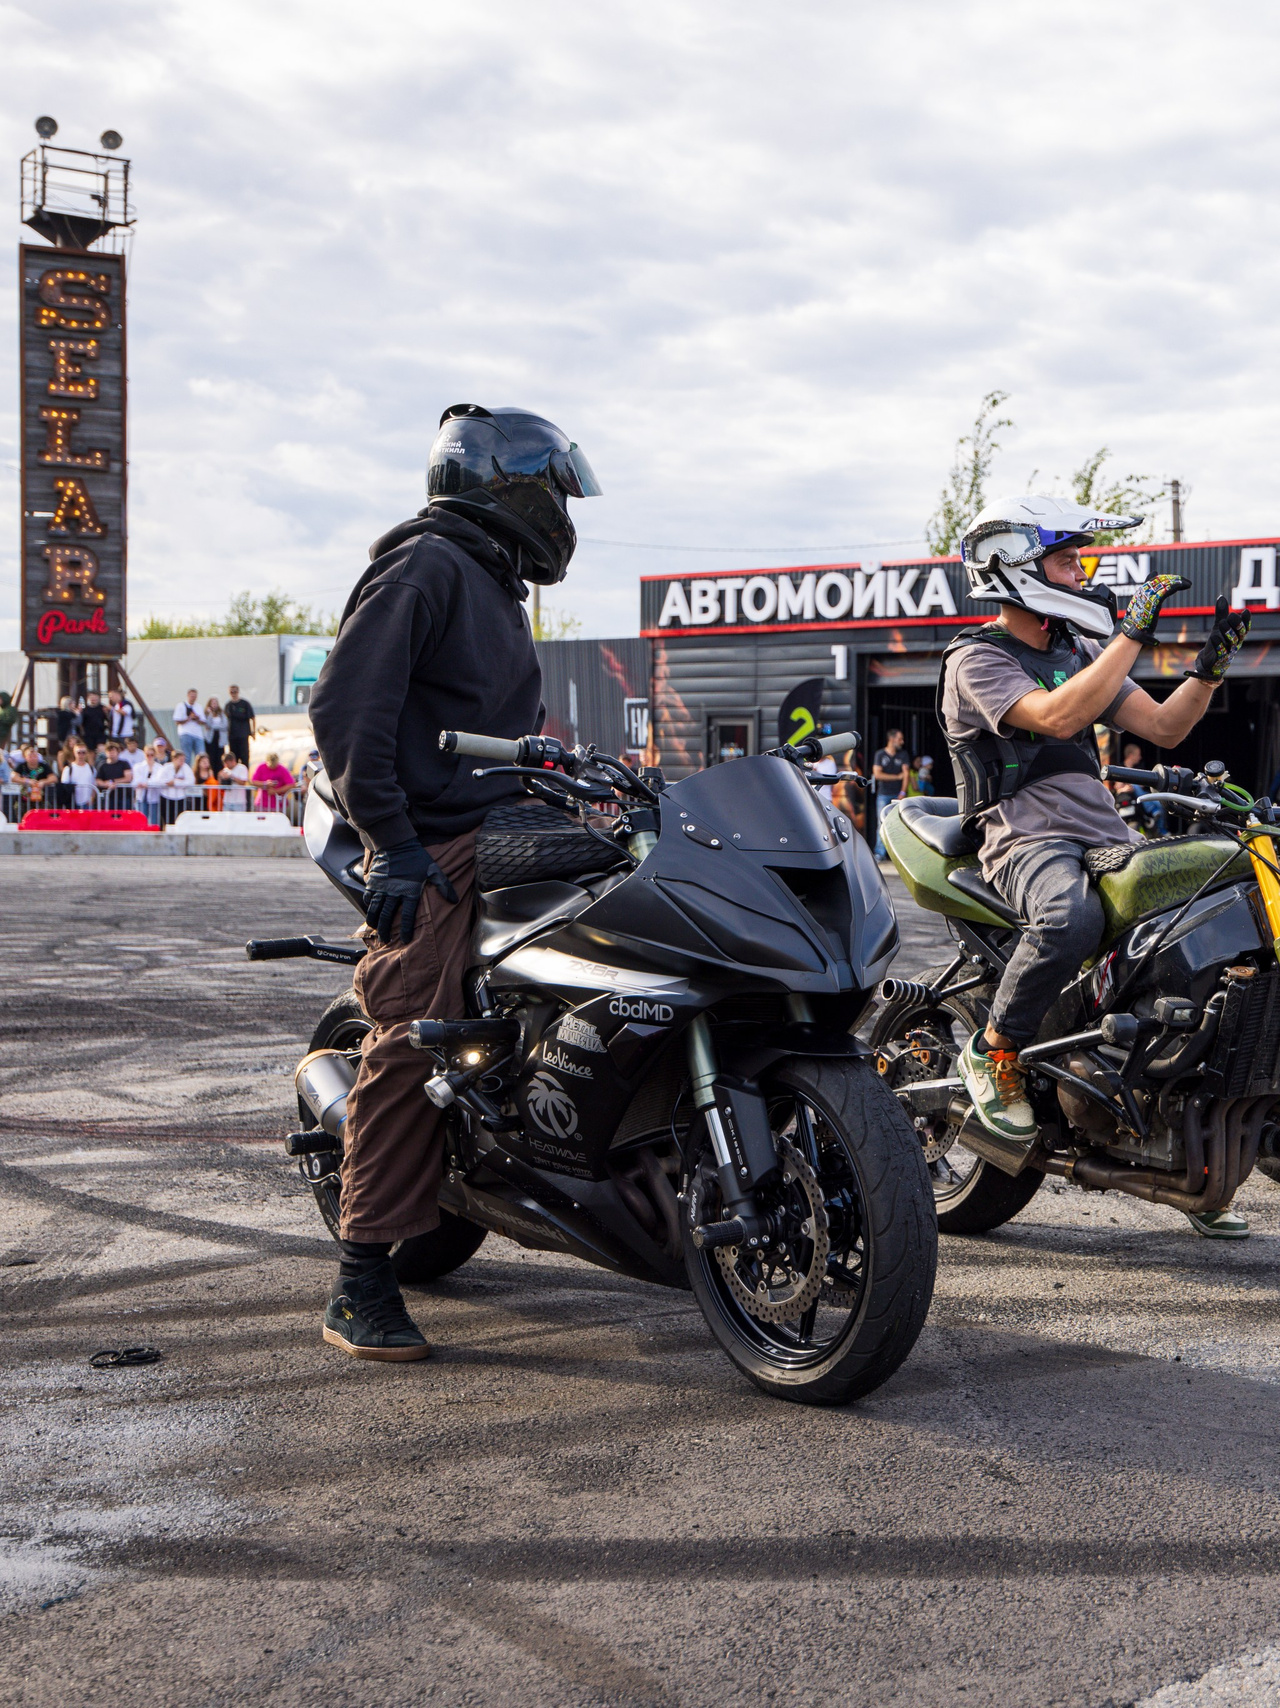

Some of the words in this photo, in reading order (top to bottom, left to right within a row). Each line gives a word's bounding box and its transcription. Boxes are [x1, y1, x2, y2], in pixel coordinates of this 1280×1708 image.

[34, 269, 111, 606] SELAR
[658, 561, 958, 628] АВТОМОЙКА
[37, 607, 109, 645] Park
[831, 645, 848, 680] 1
[568, 960, 619, 981] ZX-6R
[562, 1014, 600, 1038] METAL
[609, 998, 674, 1022] cbdMD
[542, 1041, 594, 1078] LeoVince
[472, 1197, 569, 1245] Kawasaki
